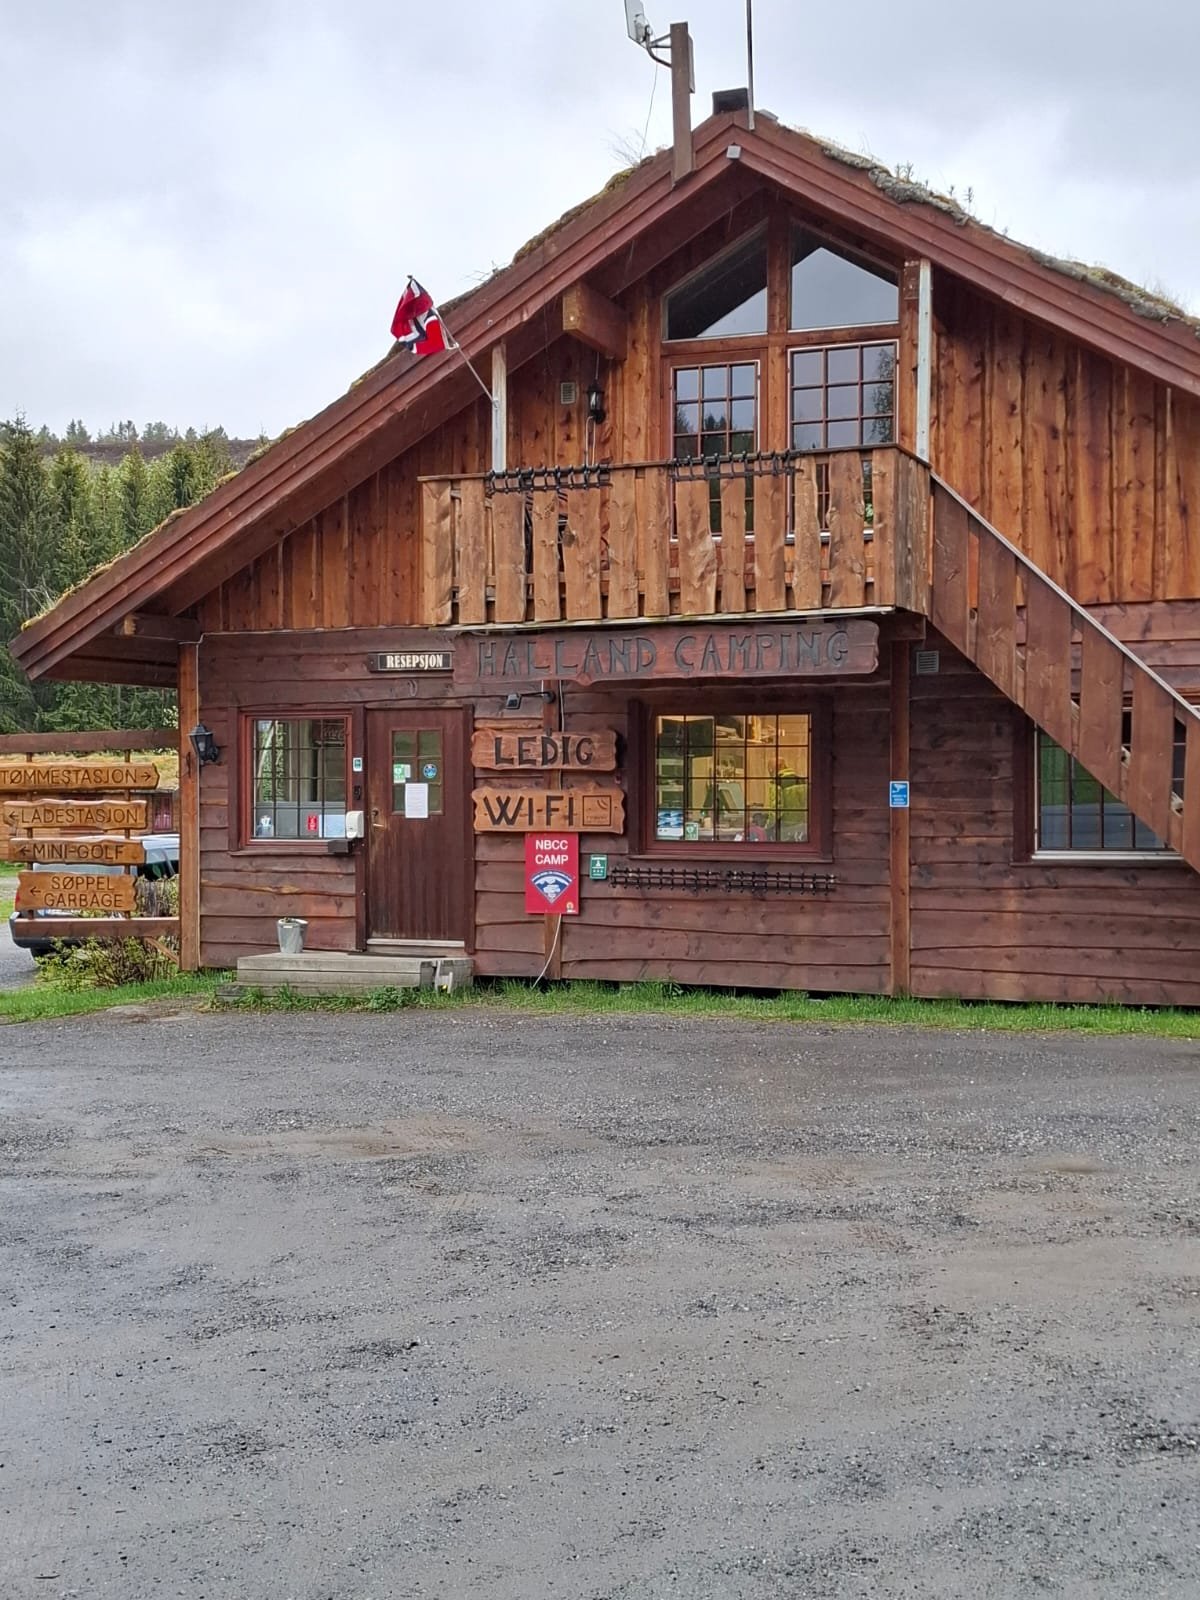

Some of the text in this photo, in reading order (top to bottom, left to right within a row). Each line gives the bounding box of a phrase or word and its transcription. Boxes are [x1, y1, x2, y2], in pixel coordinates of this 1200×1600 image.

[479, 630, 849, 677] HALLAND CAMPING
[386, 654, 444, 670] RESEPSJON
[494, 736, 594, 766] LEDIG
[0, 768, 138, 785] TØMMESTASJON
[21, 808, 138, 824] LADESTASJON
[32, 844, 124, 860] MINI-GOLF
[535, 839, 569, 850] NBCC
[534, 854, 569, 865] CAMP
[51, 876, 115, 891] SØPPEL
[43, 892, 123, 908] GARBAGE
